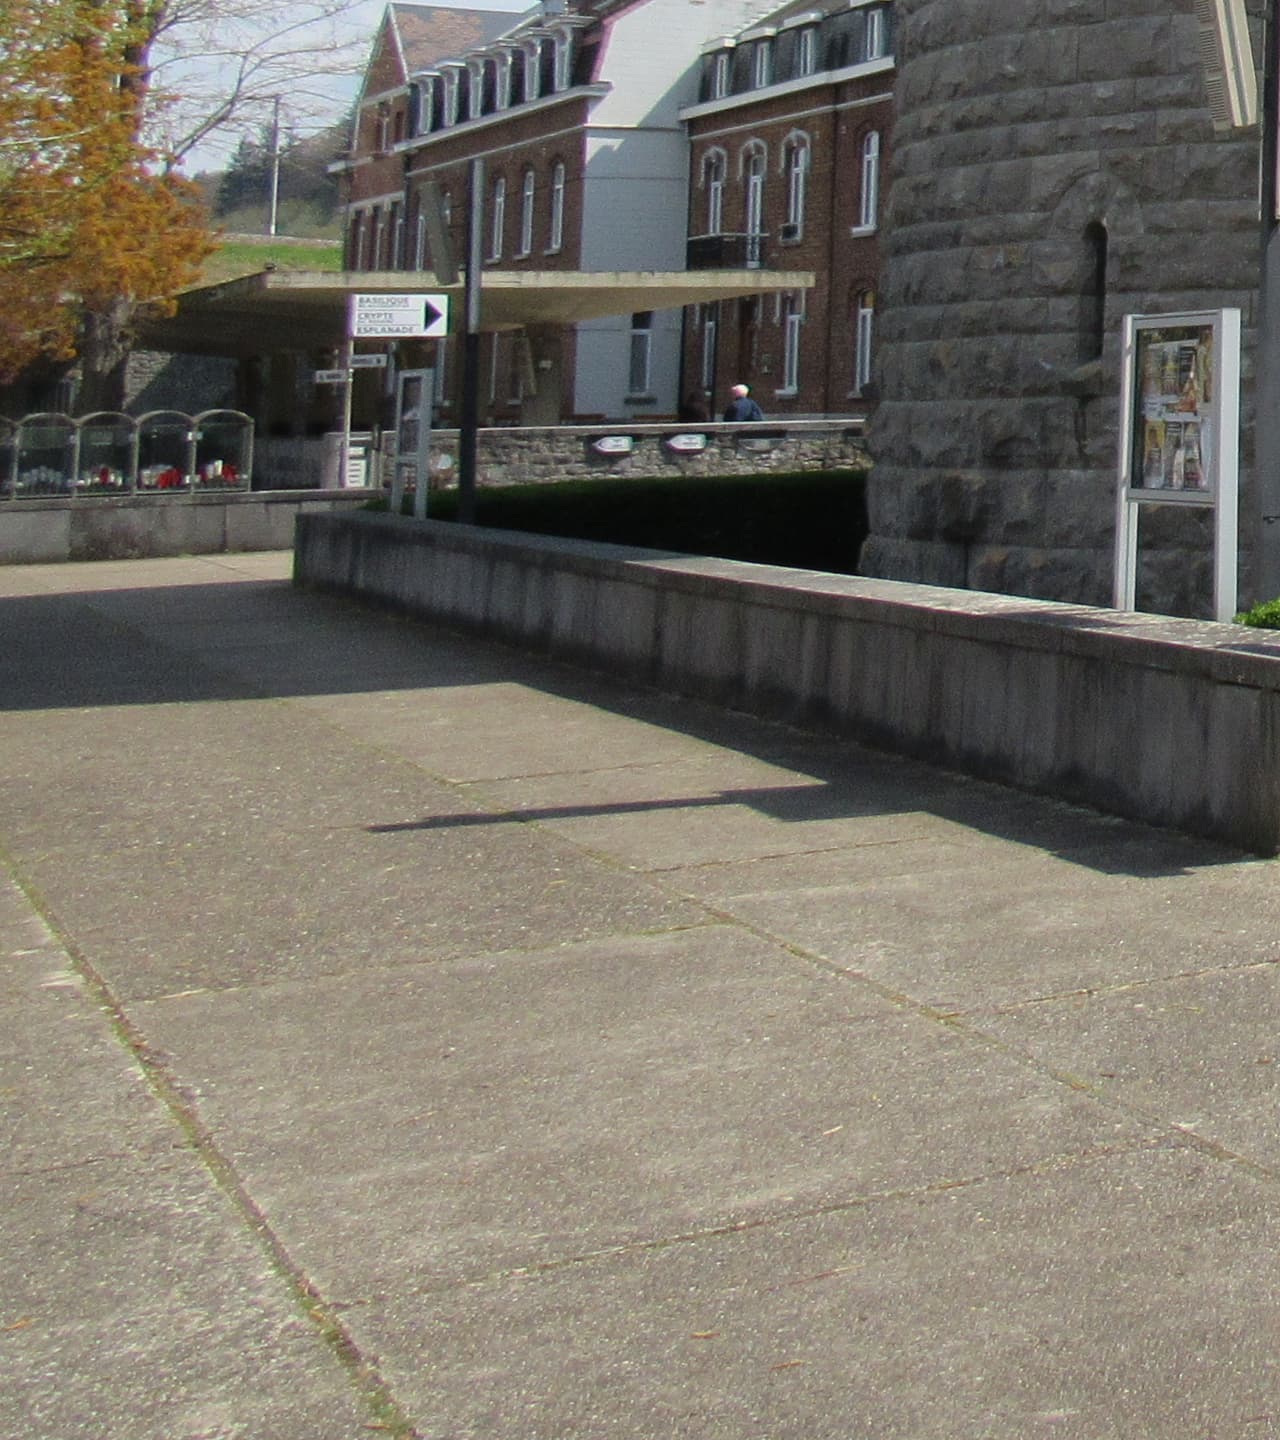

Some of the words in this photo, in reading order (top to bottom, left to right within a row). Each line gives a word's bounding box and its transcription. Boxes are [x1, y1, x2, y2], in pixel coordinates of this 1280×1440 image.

[358, 296, 409, 305] BASILIQUE
[357, 312, 393, 320] CRYPTE
[356, 326, 414, 334] ESPLANADE
